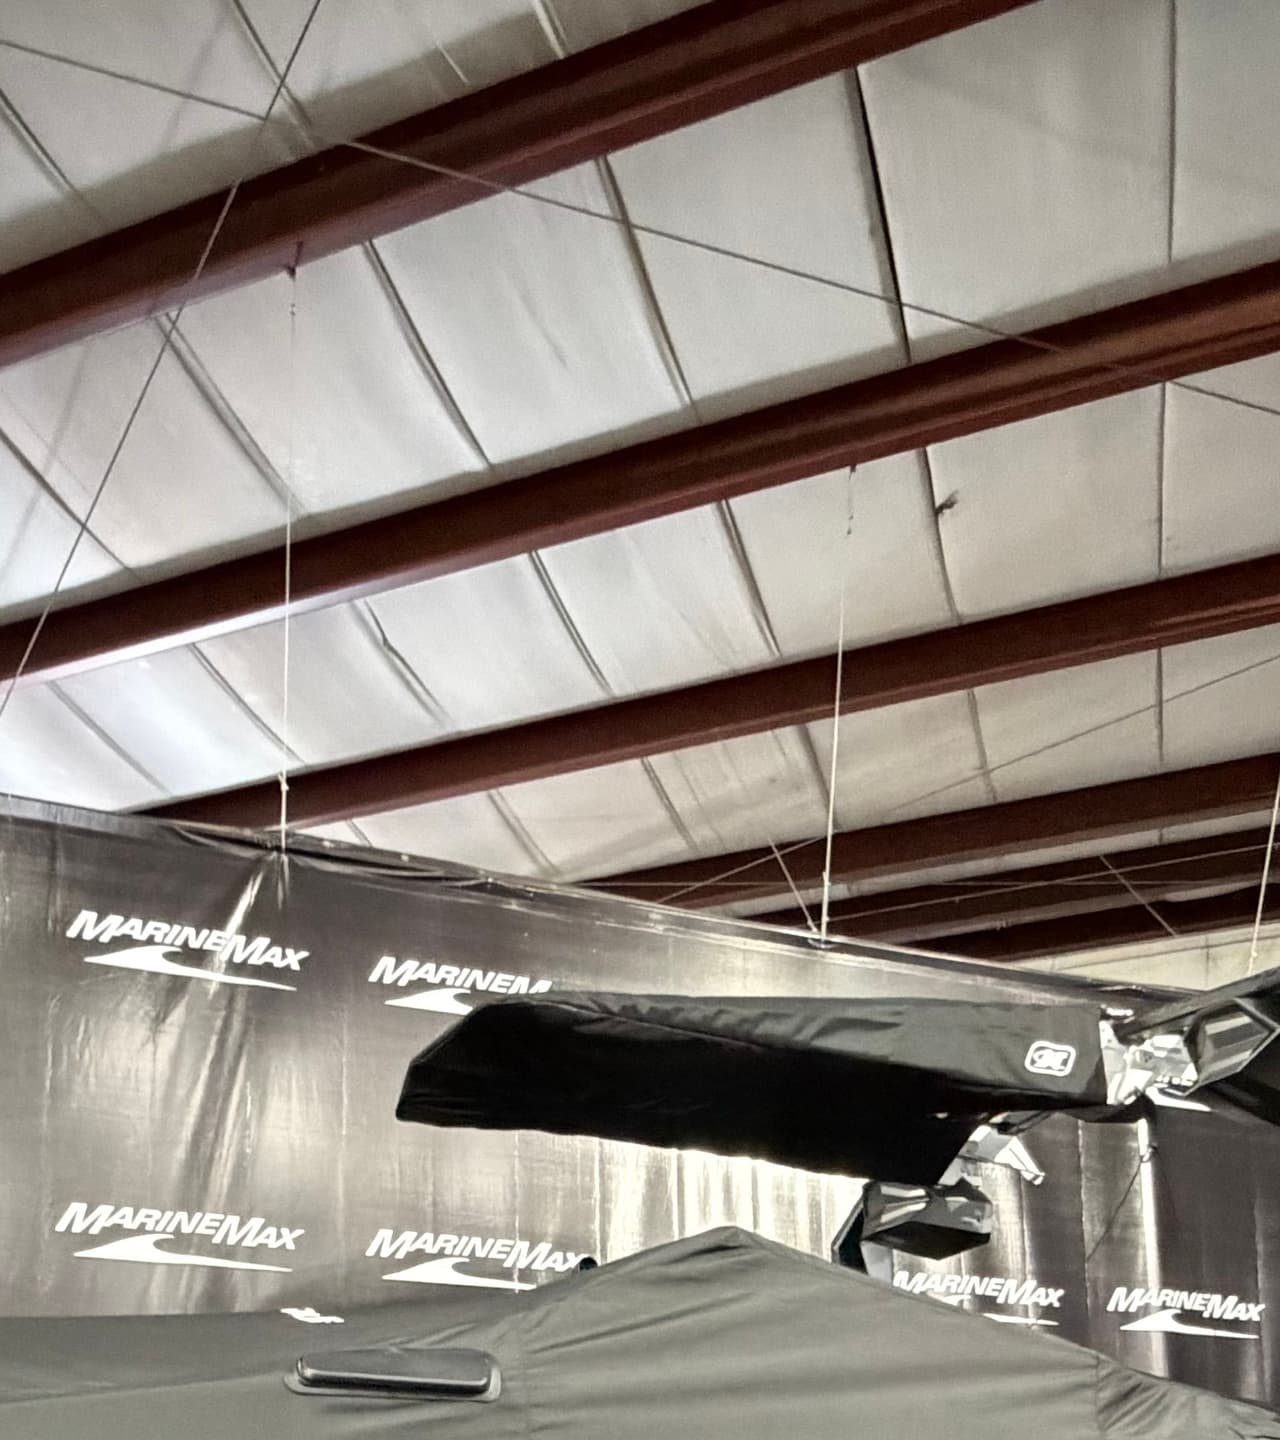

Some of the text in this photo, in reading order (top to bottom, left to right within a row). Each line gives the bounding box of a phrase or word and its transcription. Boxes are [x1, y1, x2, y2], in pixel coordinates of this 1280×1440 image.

[67, 909, 310, 972] MARINEMAX
[368, 956, 553, 994] MARINEM
[55, 1201, 305, 1251] MARINEMAX
[893, 1270, 1065, 1308] MARINEMAX
[1106, 1286, 1265, 1322] MARINEMAX
